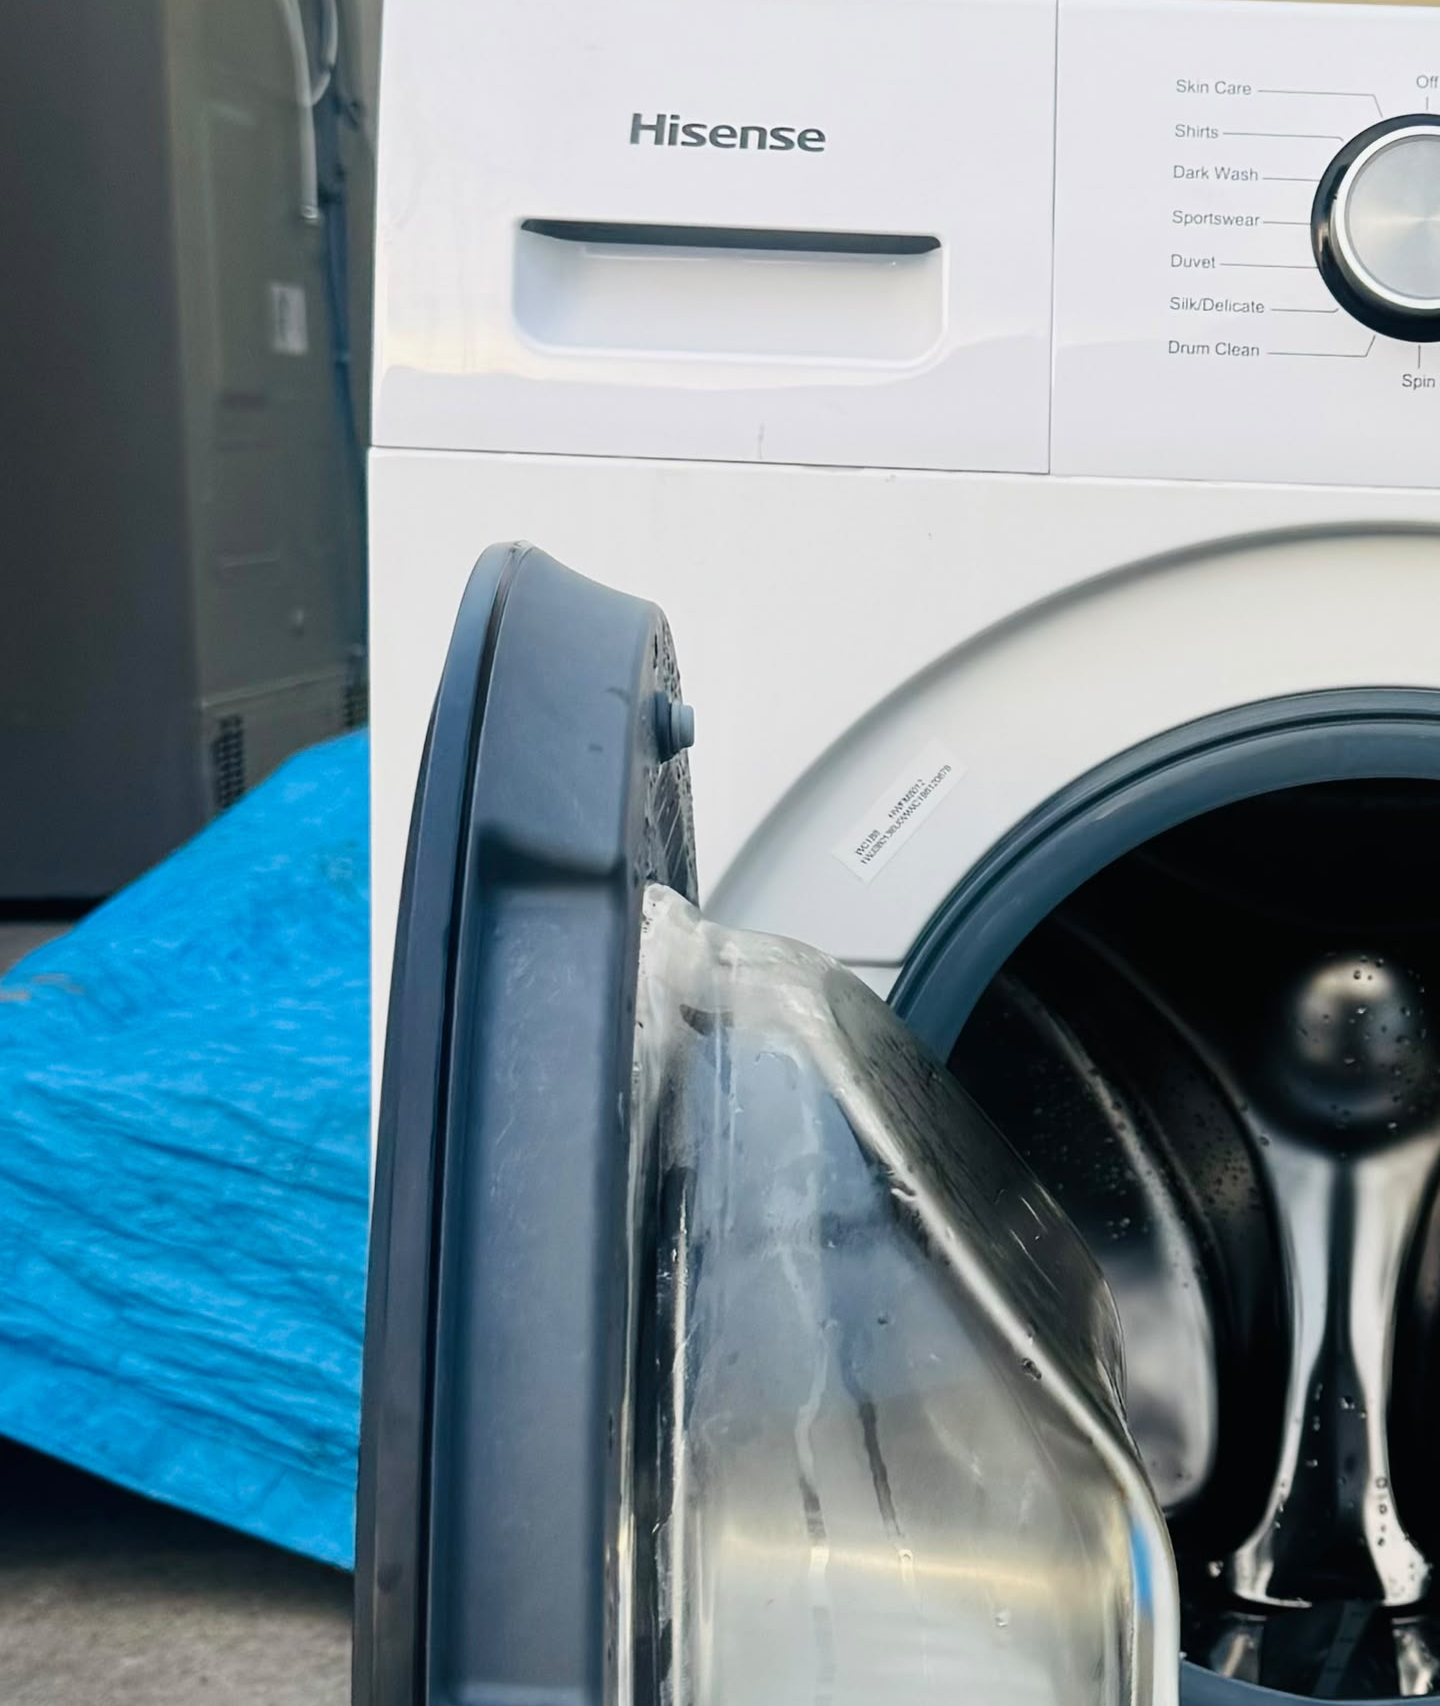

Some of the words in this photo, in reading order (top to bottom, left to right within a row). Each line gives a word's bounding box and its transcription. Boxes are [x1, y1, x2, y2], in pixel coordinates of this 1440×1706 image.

[1176, 80, 1209, 95] Skin
[1215, 81, 1252, 96] Care
[1416, 74, 1439, 89] Off
[629, 112, 827, 152] Hisense
[1174, 123, 1219, 139] Shirts
[1173, 166, 1207, 181] Dark
[1213, 167, 1258, 182] Wash
[1172, 210, 1260, 229] Sportswear
[1170, 254, 1216, 269] Duvet
[1169, 297, 1265, 314] Silk/Delicate
[1168, 341, 1210, 356] Drum
[1215, 342, 1260, 358] Clean
[1401, 373, 1436, 390] Spin
